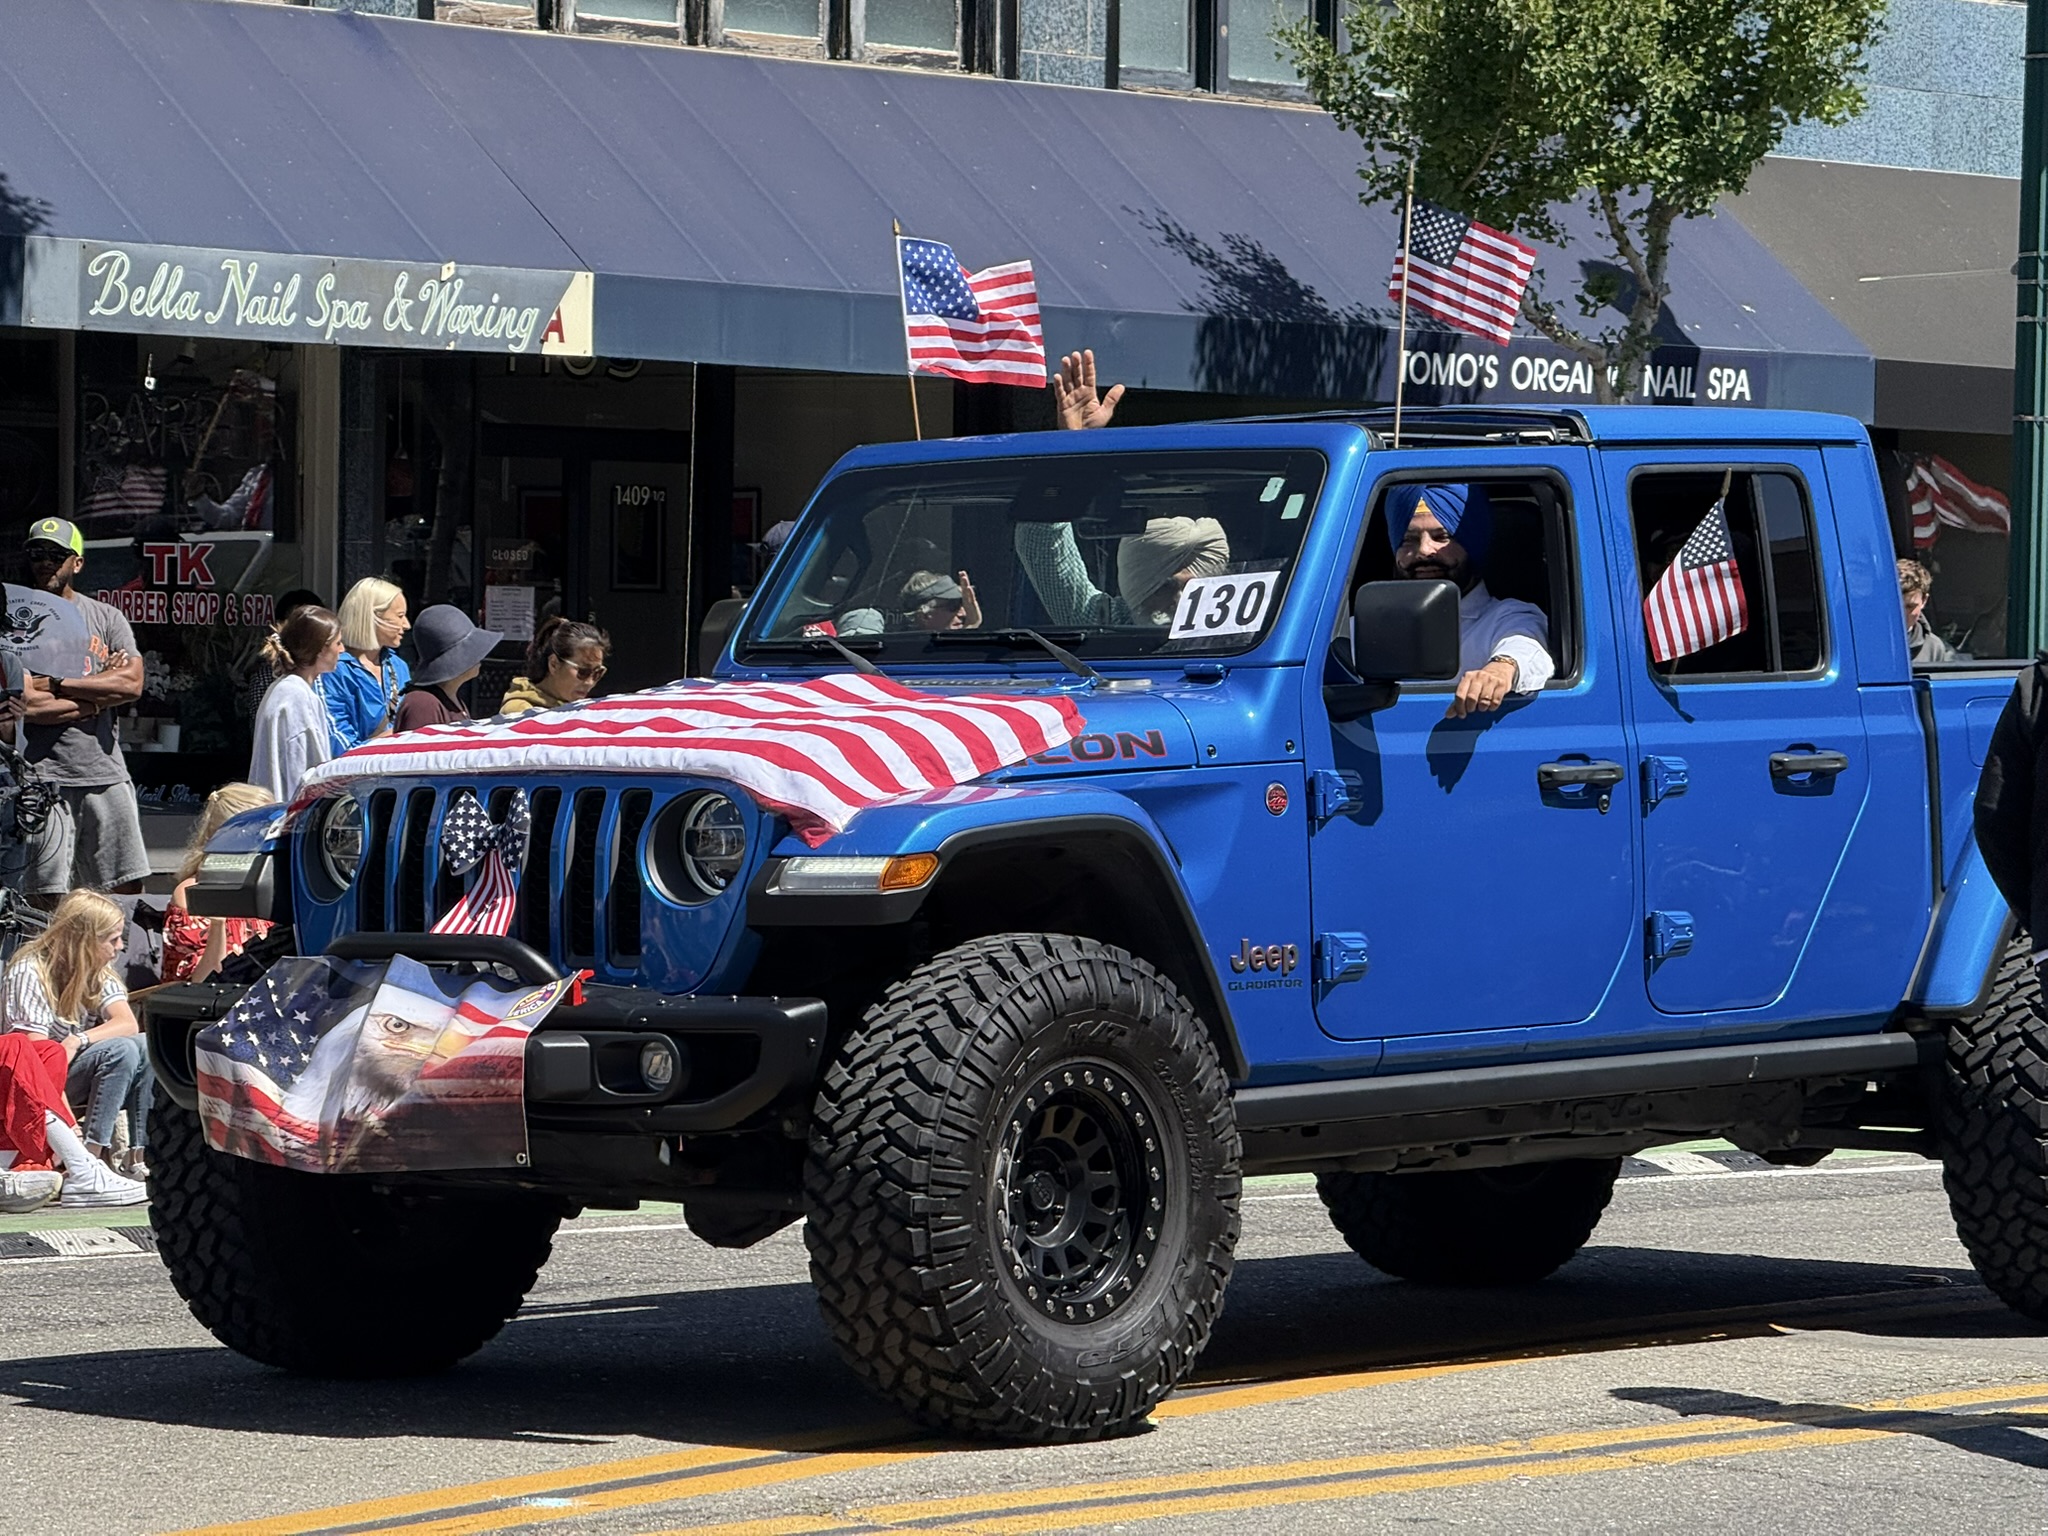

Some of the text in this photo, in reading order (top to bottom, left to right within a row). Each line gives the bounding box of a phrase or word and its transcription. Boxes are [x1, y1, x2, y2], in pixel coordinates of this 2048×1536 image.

[88, 250, 539, 352] Bella Nail Spa & Waxing
[1401, 350, 1751, 401] TOMO'S ORGA NAIL SPA
[614, 485, 650, 506] 1409
[143, 543, 215, 585] TK
[491, 549, 529, 562] CLOSED
[172, 592, 219, 625] SHOP
[224, 593, 237, 626] &
[242, 594, 275, 626] SPA
[1178, 581, 1266, 631] 130
[1230, 938, 1299, 977] Jeep
[1227, 979, 1303, 992] GLADIATOR
[508, 1000, 545, 1017] ERICA
